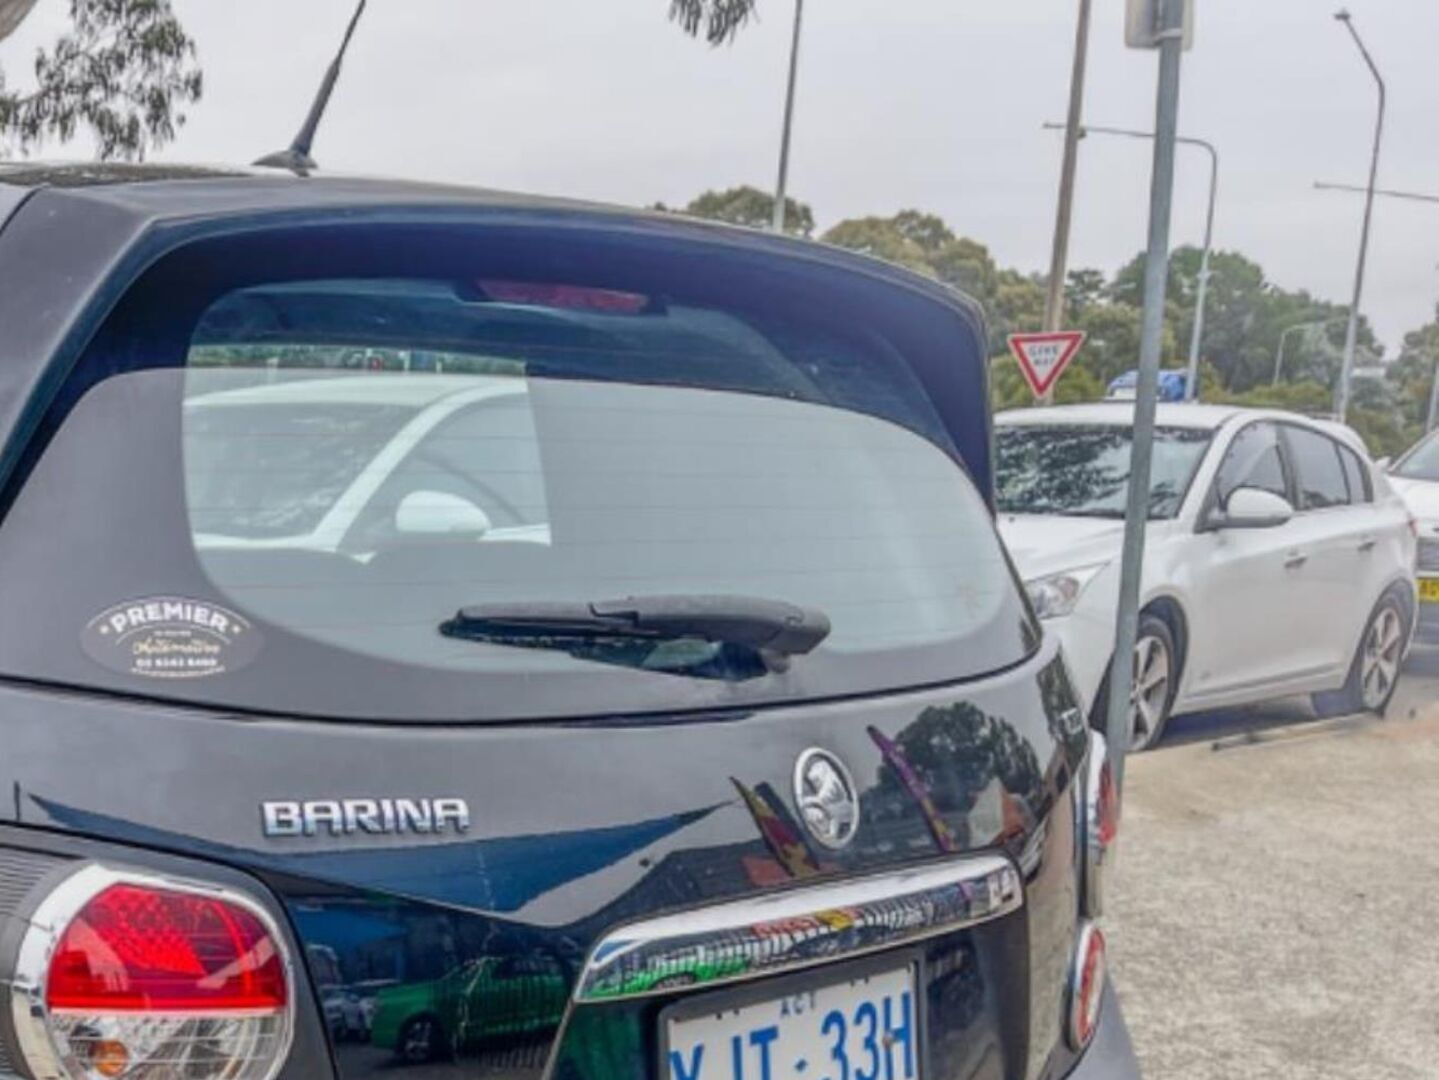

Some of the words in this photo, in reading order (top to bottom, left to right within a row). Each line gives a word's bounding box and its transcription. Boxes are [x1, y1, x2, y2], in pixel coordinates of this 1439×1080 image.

[1028, 345, 1058, 357] GIVE
[110, 601, 229, 633] PREMIER
[262, 798, 470, 836] BARINA
[780, 992, 816, 1019] ACT
